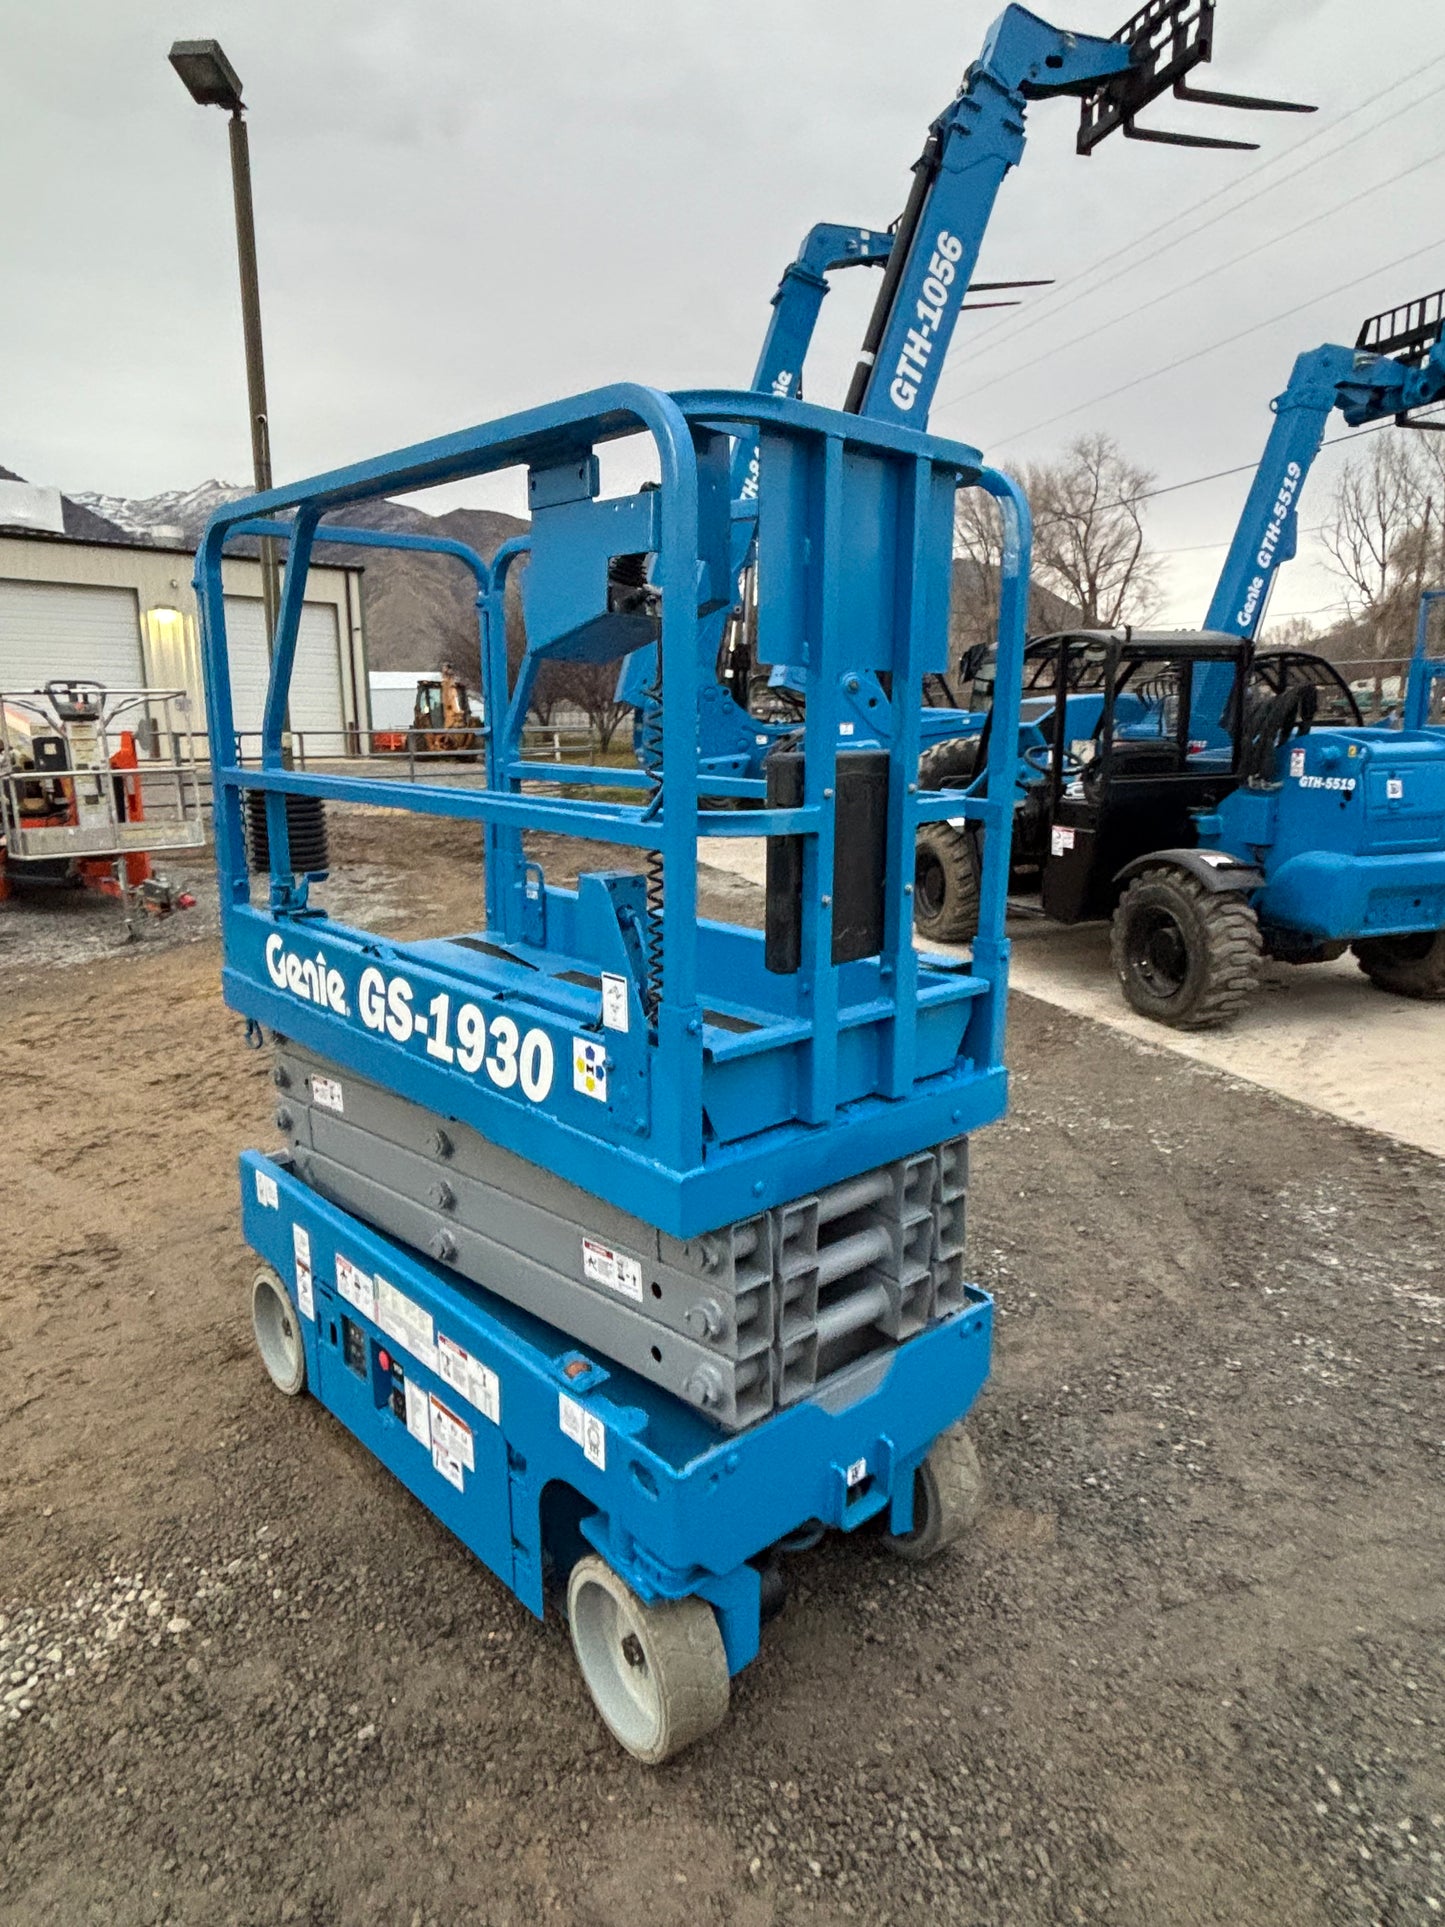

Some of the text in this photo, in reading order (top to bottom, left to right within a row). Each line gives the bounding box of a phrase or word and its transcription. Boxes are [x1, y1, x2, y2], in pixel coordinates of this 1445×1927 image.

[890, 231, 963, 411] GTH-1056
[1236, 461, 1301, 627] Genie GTH-5519
[1298, 775, 1356, 791] GTH-5519
[264, 932, 350, 1017] Genie
[358, 966, 555, 1103] GS-1930
